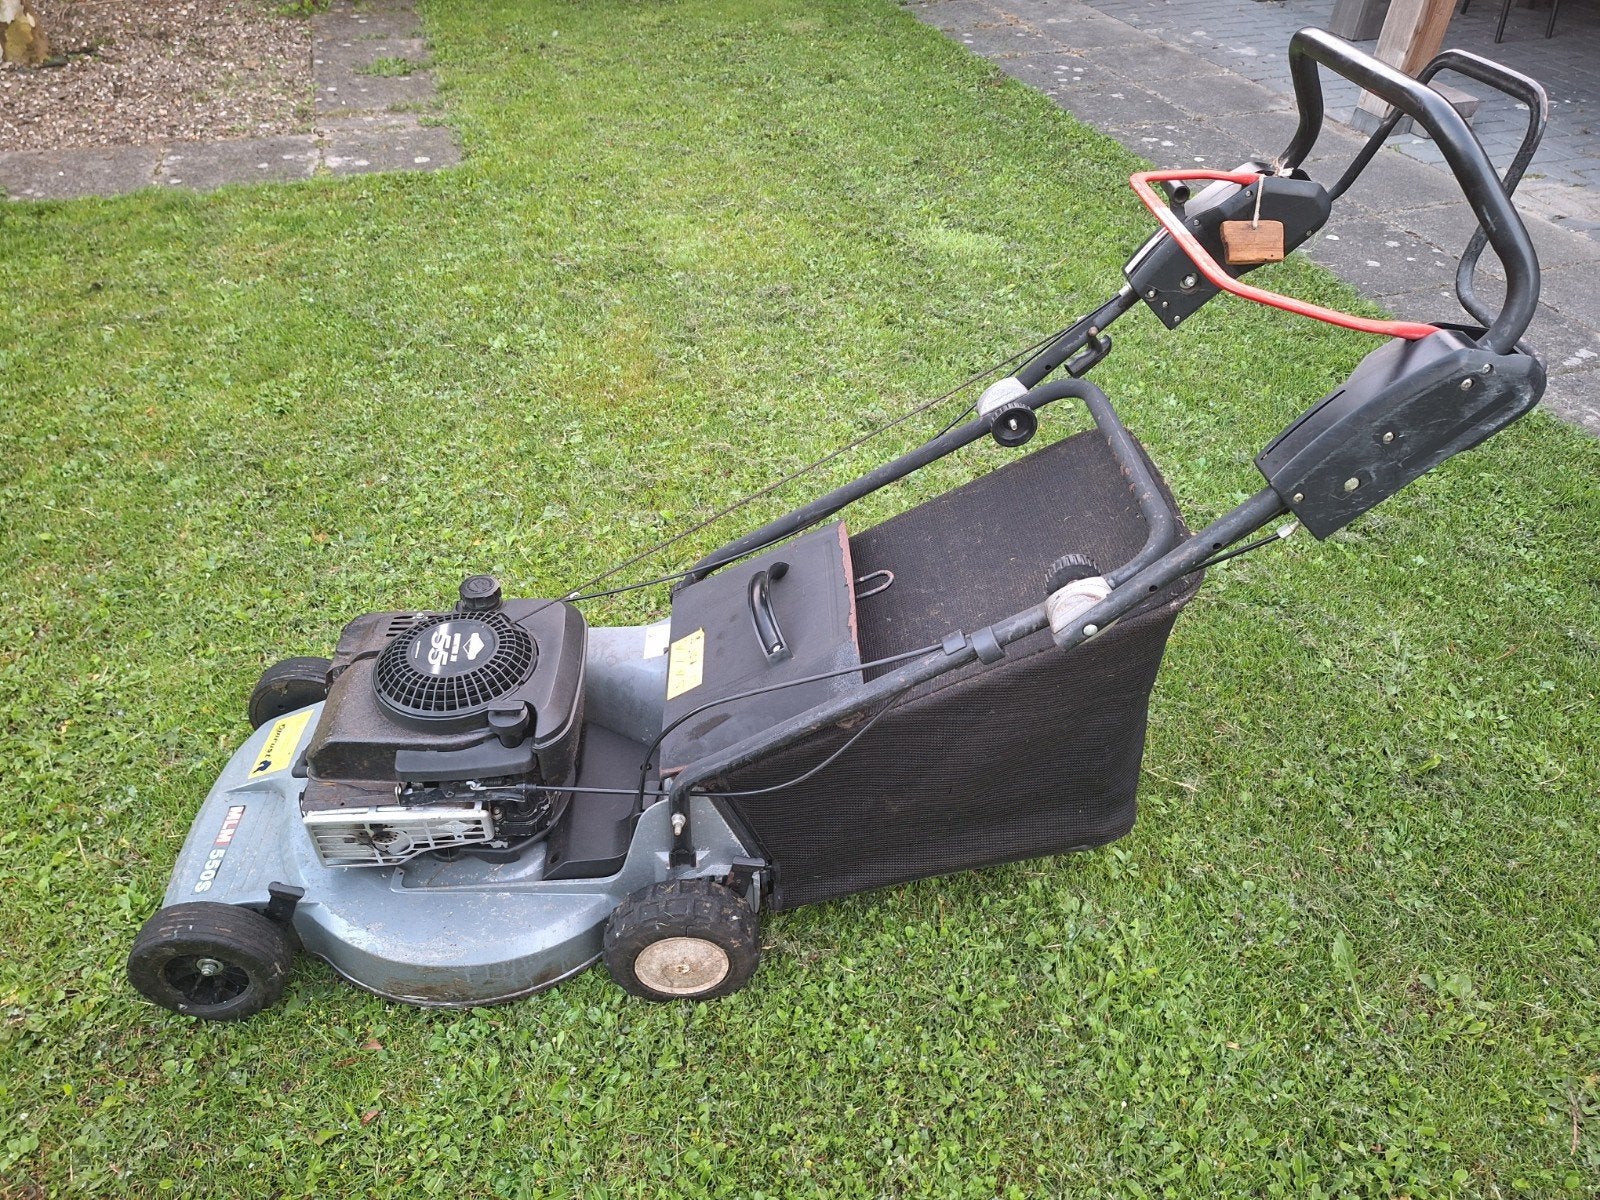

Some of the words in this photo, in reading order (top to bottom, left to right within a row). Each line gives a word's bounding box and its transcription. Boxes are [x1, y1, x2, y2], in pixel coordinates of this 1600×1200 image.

[428, 630, 451, 665] 55
[218, 806, 245, 843] MLM
[194, 848, 226, 893] 550S
